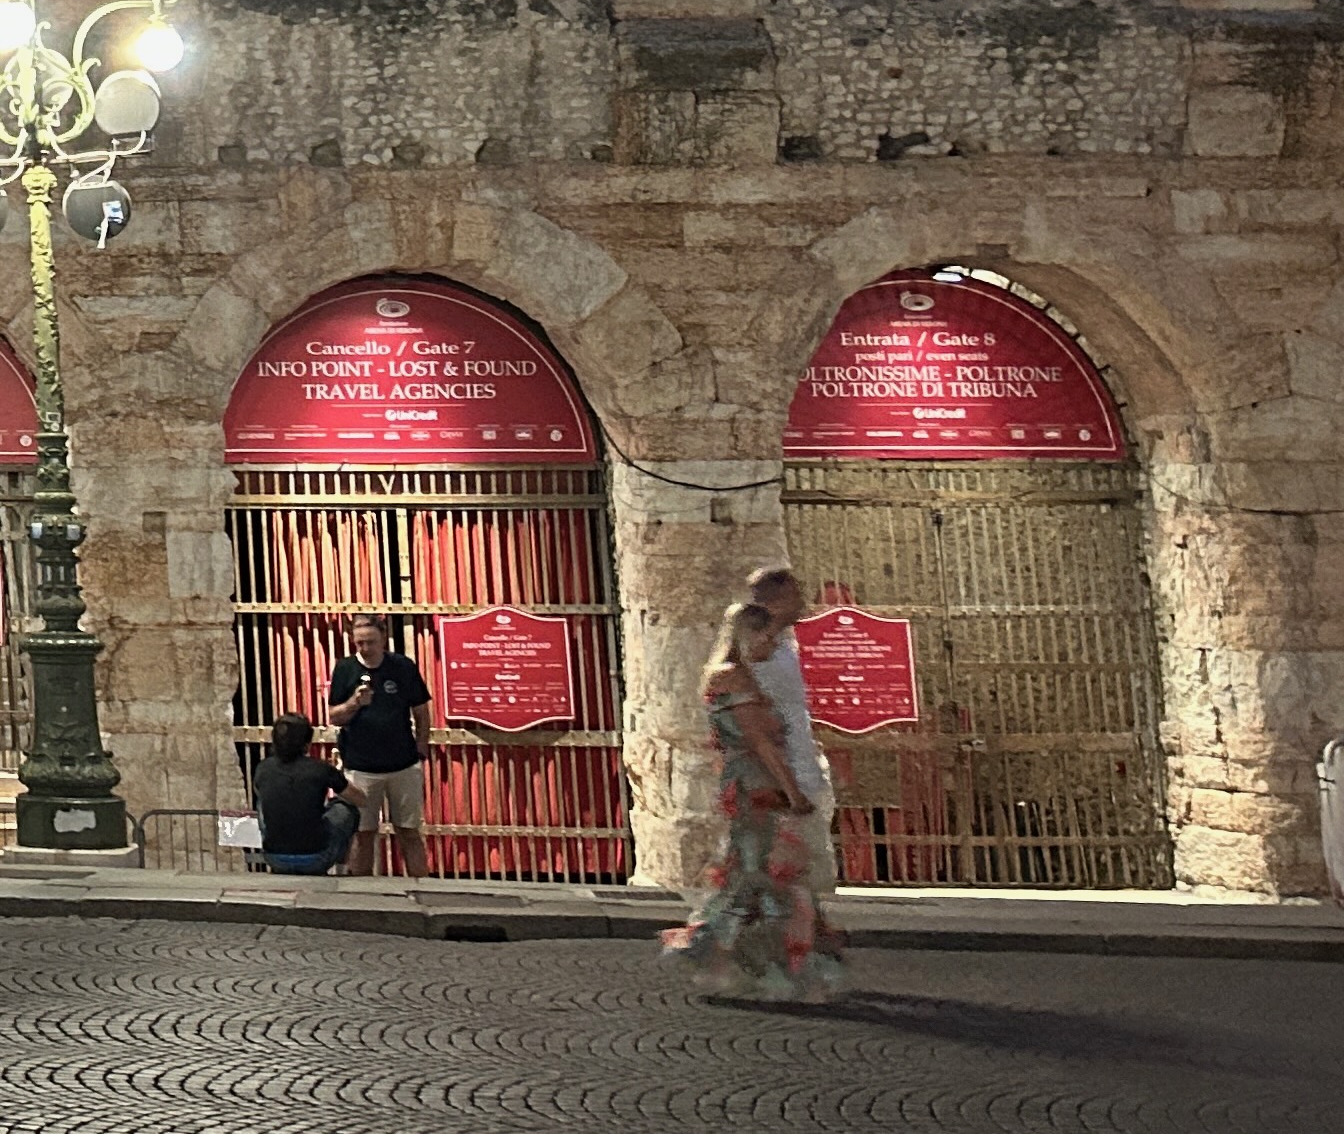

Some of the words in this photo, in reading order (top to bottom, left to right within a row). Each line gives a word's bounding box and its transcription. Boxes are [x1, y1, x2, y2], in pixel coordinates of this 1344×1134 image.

[840, 332, 911, 346] Entrata
[932, 332, 980, 346] Gate
[983, 332, 996, 346] 8
[306, 340, 391, 355] Cancello
[412, 341, 460, 355] Gate
[463, 341, 475, 354] 7
[855, 350, 886, 364] posti
[257, 360, 307, 377] INFO
[311, 360, 374, 377] POINT
[388, 360, 440, 377] LOST
[442, 360, 459, 377] &
[463, 360, 537, 377] FOUND
[956, 366, 1064, 382] POLTRONE
[301, 383, 386, 400] TRAVEL
[389, 383, 497, 400] AGENCIES
[811, 381, 919, 398] POLTRONE
[921, 381, 945, 398] DI
[947, 381, 1039, 398] TRIBUNA
